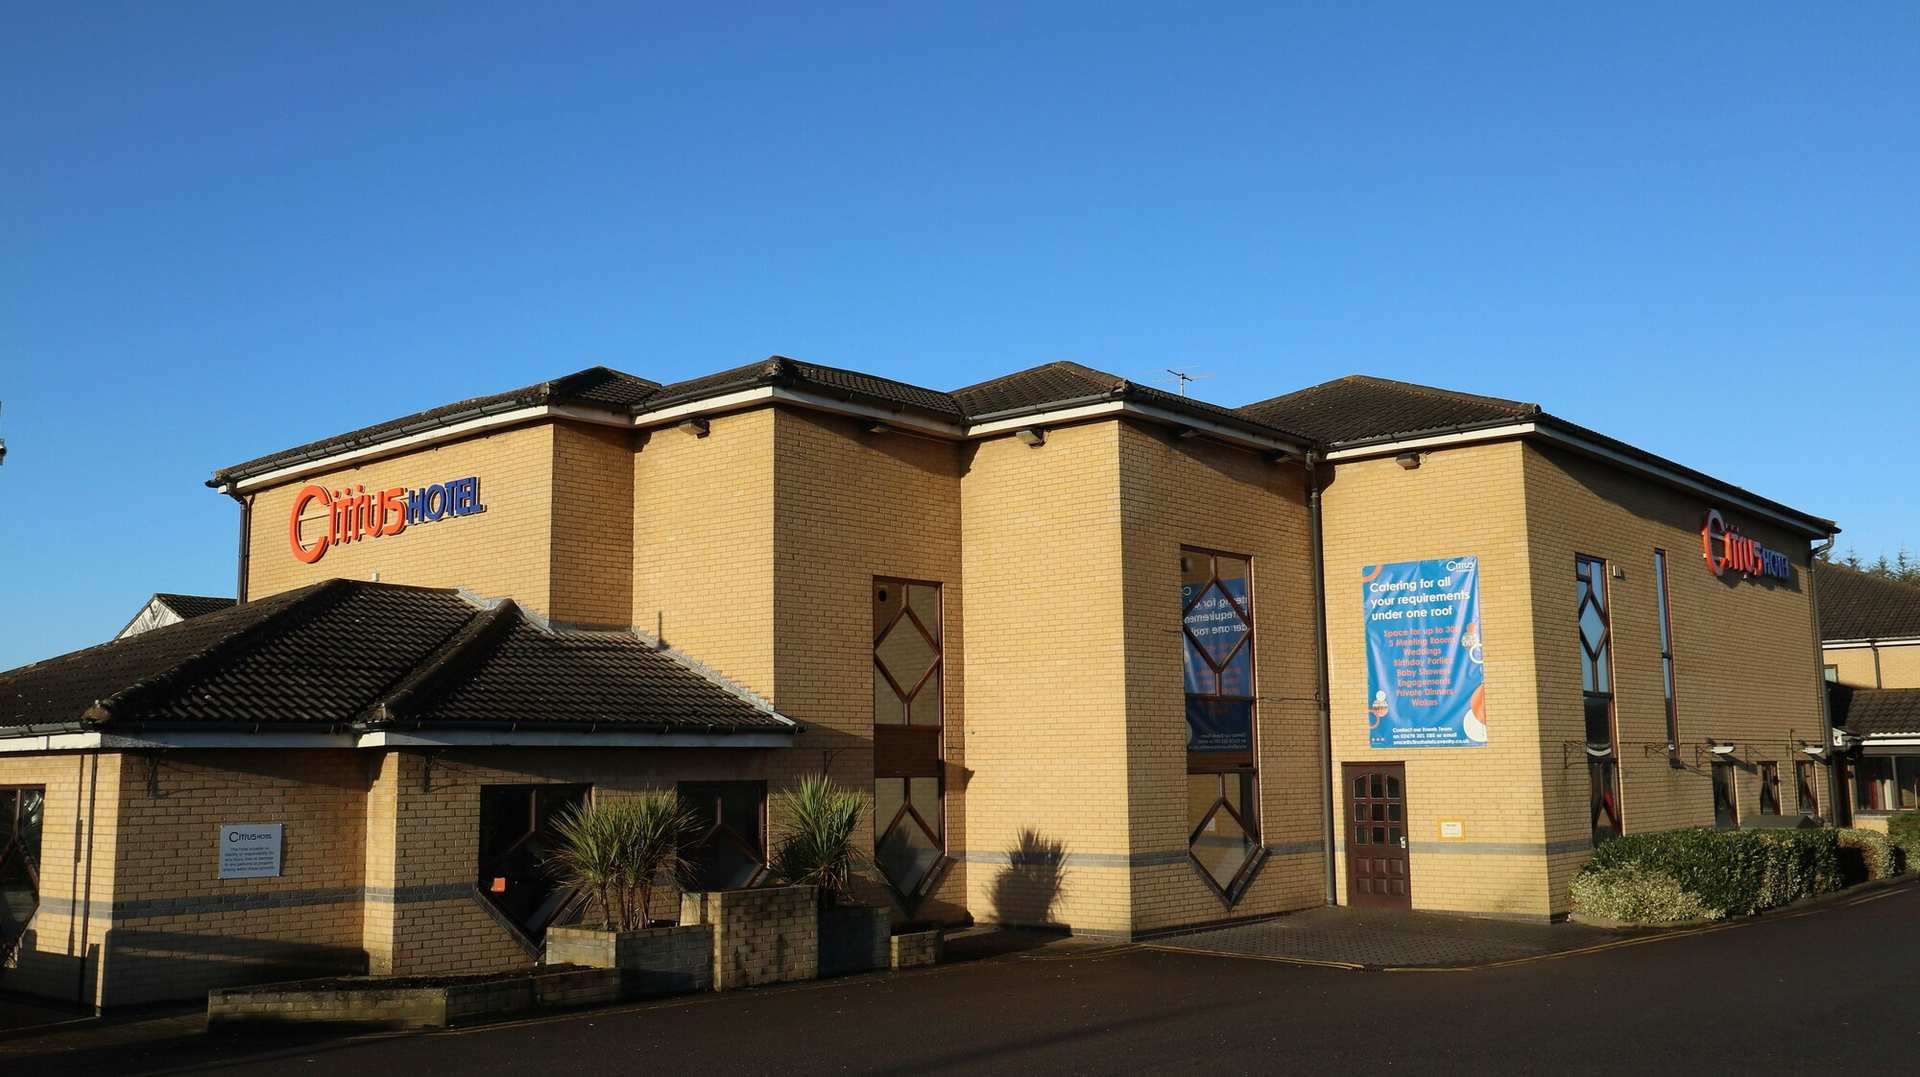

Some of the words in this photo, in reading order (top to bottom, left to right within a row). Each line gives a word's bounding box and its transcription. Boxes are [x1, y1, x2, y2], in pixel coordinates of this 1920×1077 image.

[407, 477, 485, 524] HOTEL
[1370, 581, 1417, 592] Catering
[1420, 578, 1434, 588] for
[1437, 576, 1451, 587] all
[1370, 597, 1395, 609] your
[1398, 590, 1470, 605] requirements
[1372, 609, 1403, 620] under
[1406, 609, 1427, 617] one
[1431, 605, 1454, 616] roof
[1423, 627, 1433, 636] up
[1435, 625, 1443, 633] to
[1403, 647, 1441, 656] Weddings
